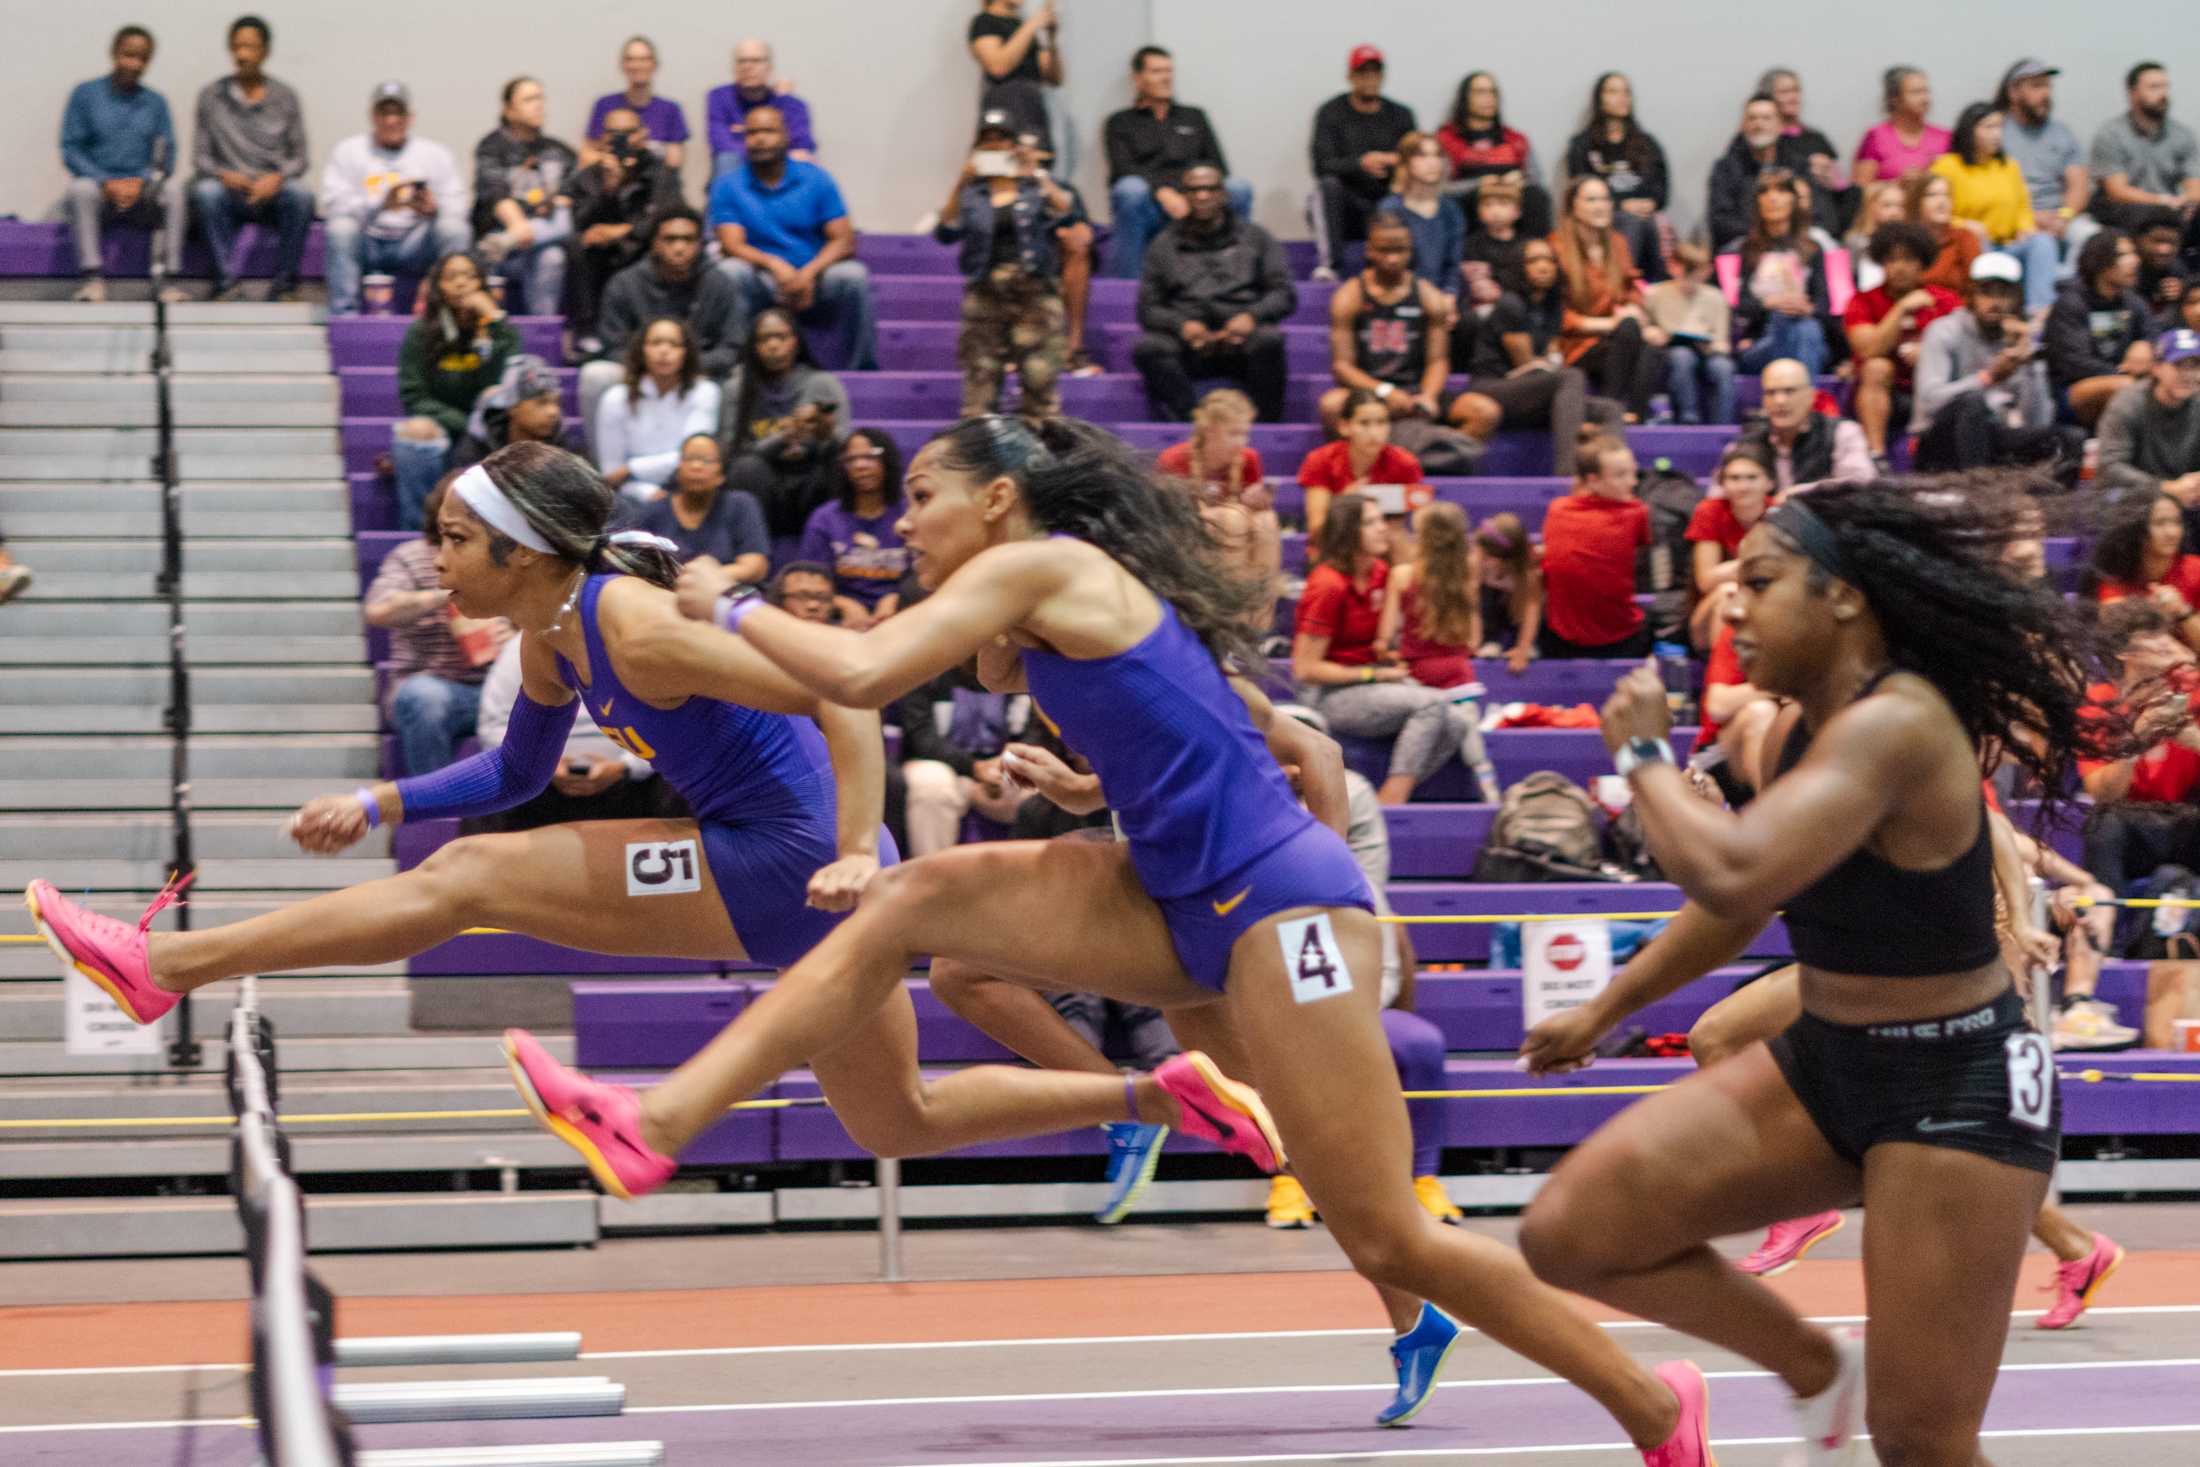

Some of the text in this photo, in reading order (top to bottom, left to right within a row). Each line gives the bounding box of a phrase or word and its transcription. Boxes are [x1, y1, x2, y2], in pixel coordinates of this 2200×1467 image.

[632, 847, 694, 886] 5
[1298, 922, 1337, 989] 4
[2020, 1037, 2044, 1116] 3
